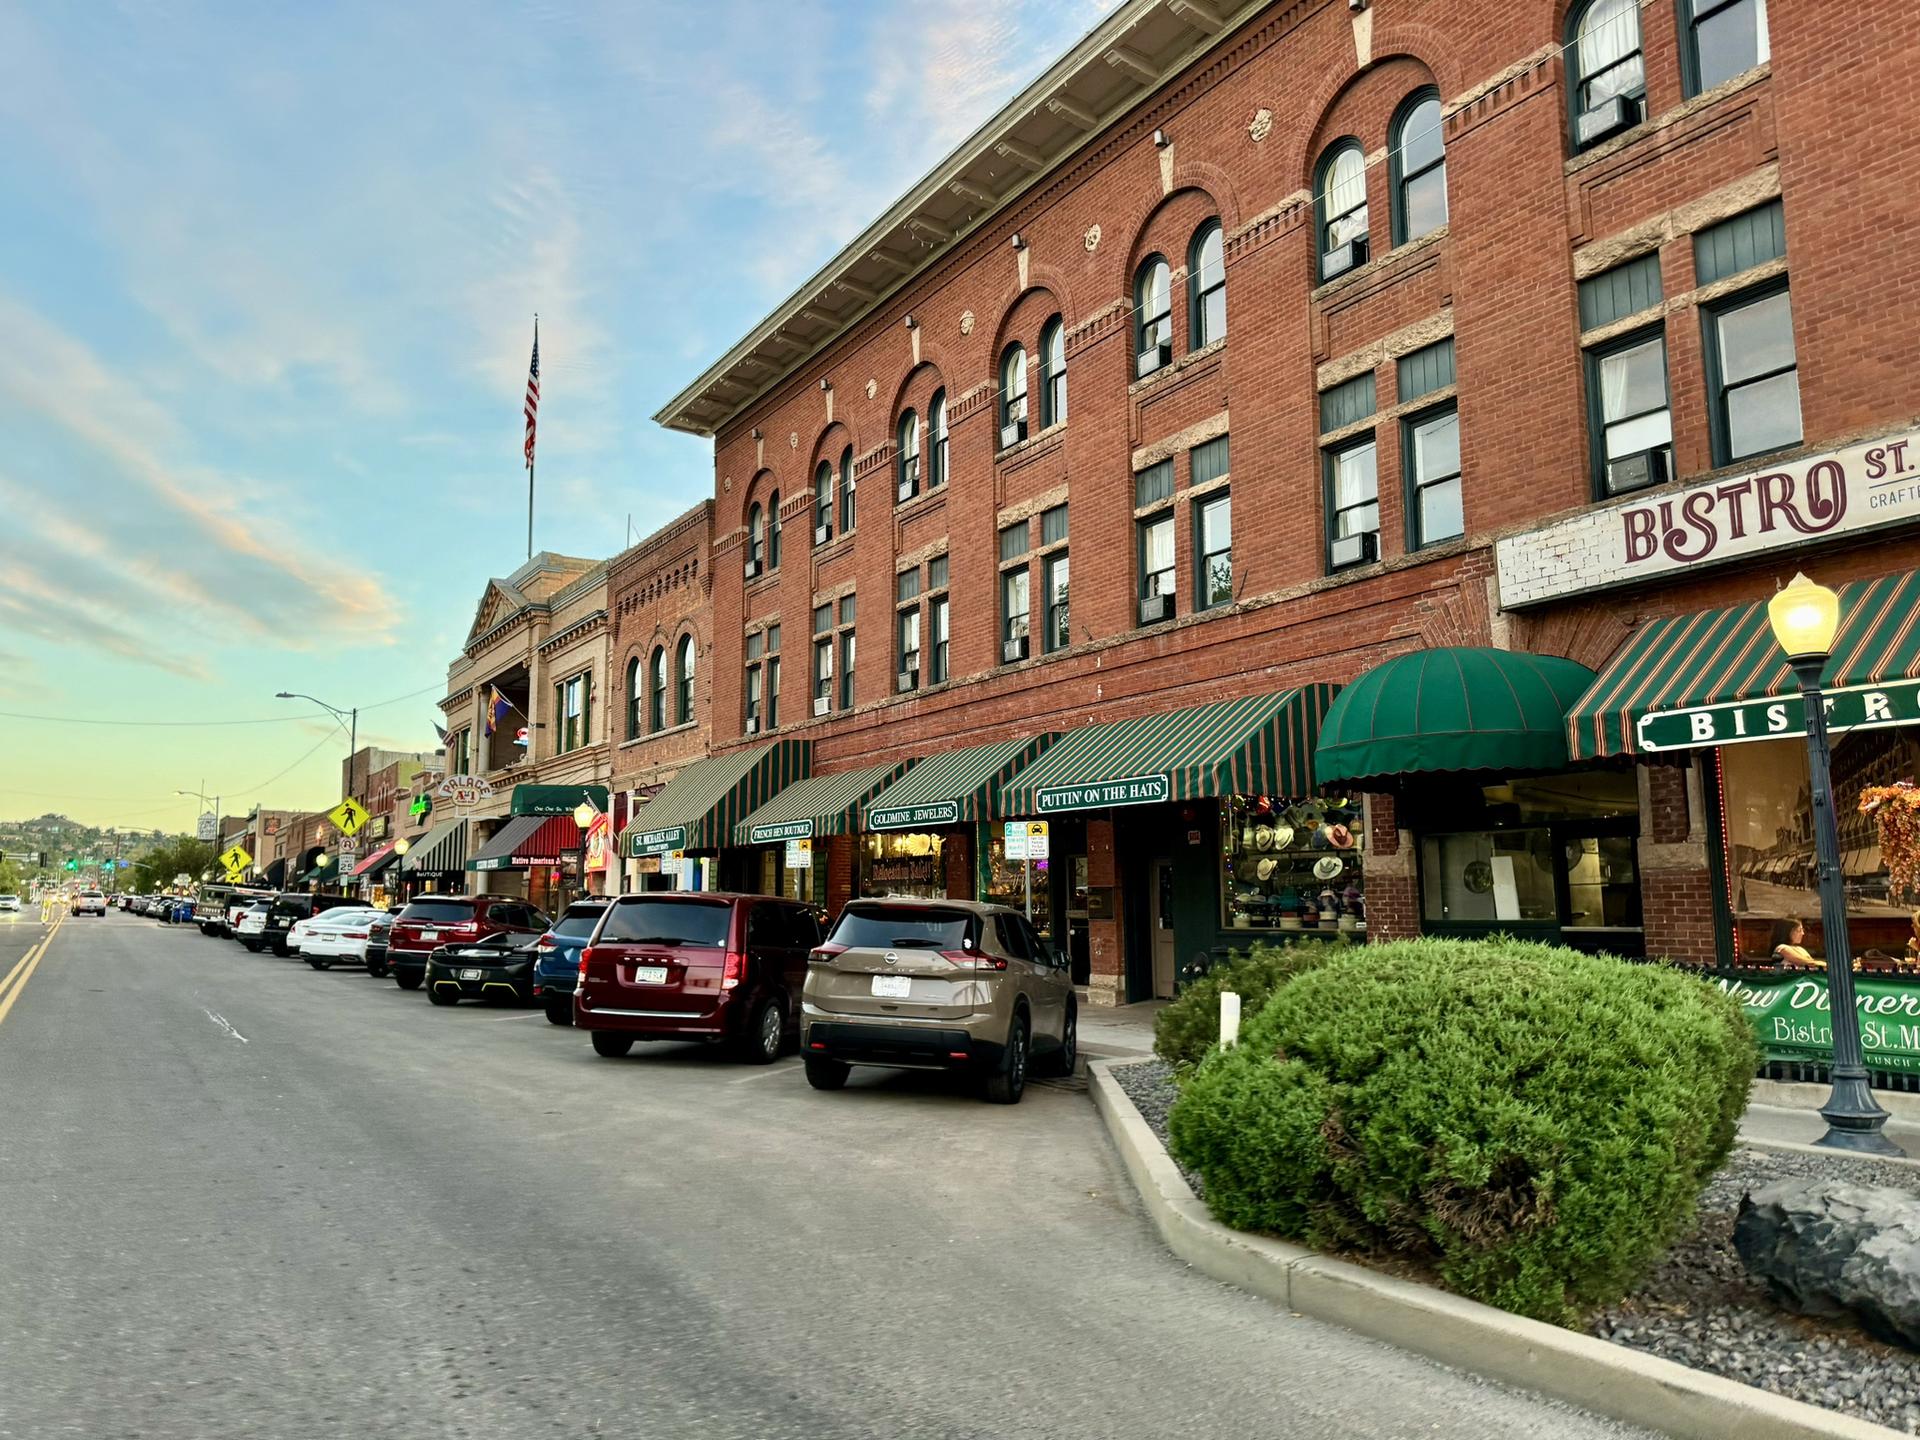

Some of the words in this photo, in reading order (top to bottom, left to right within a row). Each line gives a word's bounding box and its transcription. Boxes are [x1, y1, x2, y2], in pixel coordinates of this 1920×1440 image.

[1621, 460, 1848, 564] BISTRO
[1864, 438, 1915, 479] ST.
[1689, 689, 1920, 741] BISR
[442, 777, 490, 795] PALACE
[1042, 790, 1082, 807] PUTTIN'
[1084, 789, 1101, 803] ON
[1103, 786, 1127, 801] THE
[1130, 781, 1161, 798] HATS
[874, 811, 911, 825] GOLDMINE
[913, 806, 953, 821] JEWELERS
[754, 829, 772, 839] FRENCH
[340, 863, 354, 871] 25
[512, 857, 528, 865] Native
[530, 857, 554, 865] American
[1790, 982, 1920, 1016] Diner
[1772, 1016, 1834, 1044] Bistr
[1866, 1055, 1911, 1067] LUNCH
